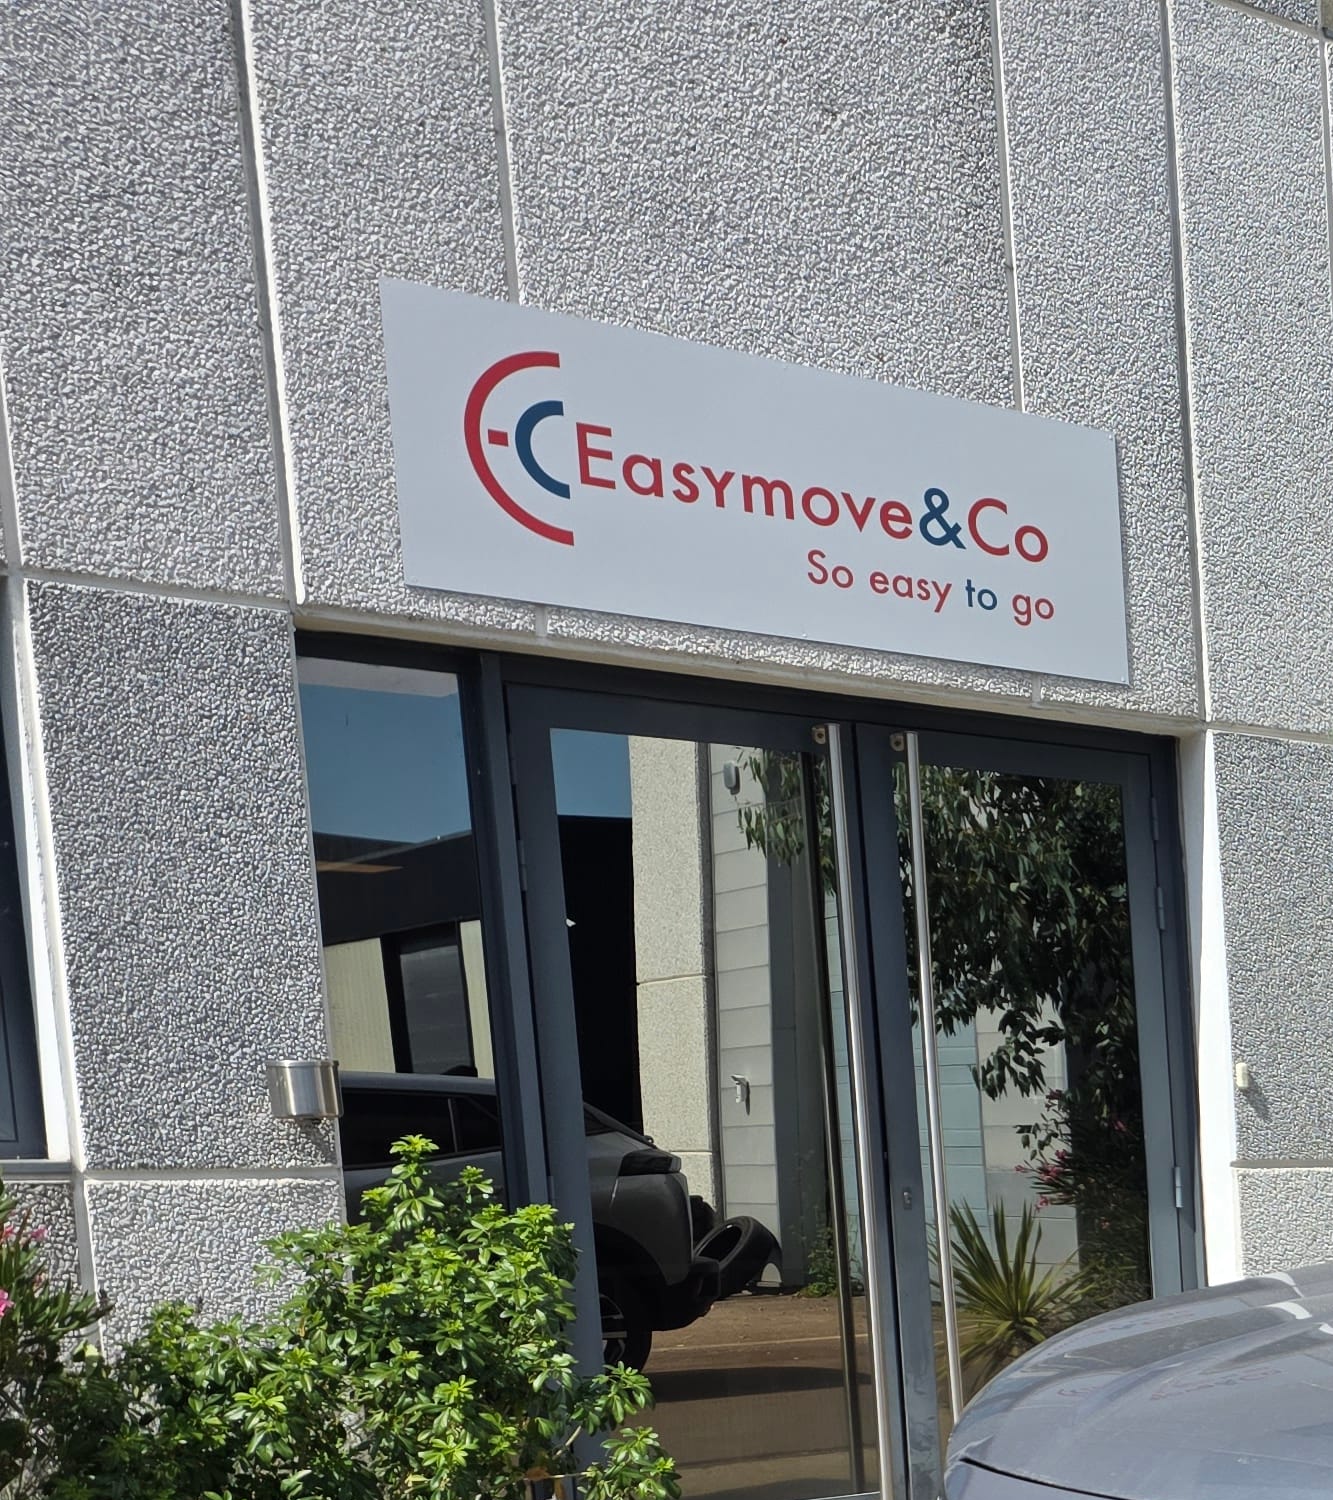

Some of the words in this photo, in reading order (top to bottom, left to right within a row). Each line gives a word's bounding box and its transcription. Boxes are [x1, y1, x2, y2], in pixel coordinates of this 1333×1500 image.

[574, 421, 1050, 564] Easymove&Co
[806, 549, 855, 590] So
[869, 570, 953, 614] easy
[964, 578, 998, 611] to
[1011, 590, 1056, 627] go
